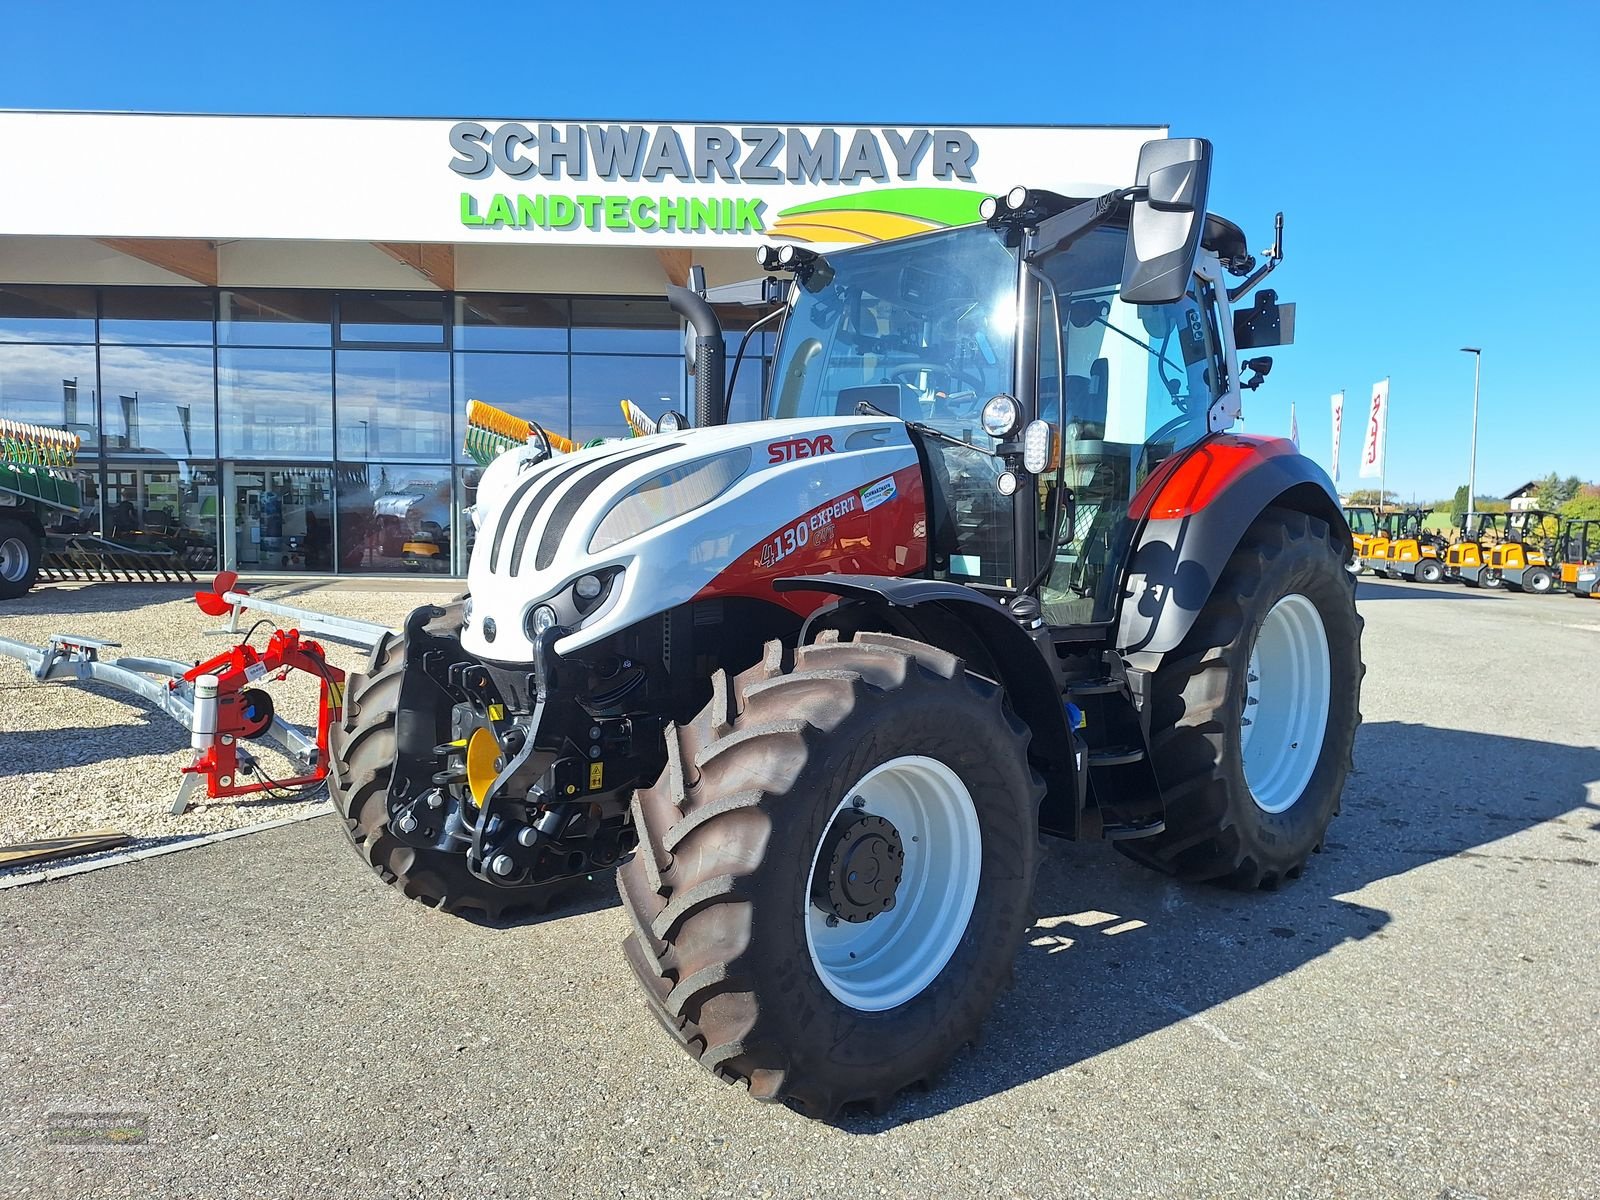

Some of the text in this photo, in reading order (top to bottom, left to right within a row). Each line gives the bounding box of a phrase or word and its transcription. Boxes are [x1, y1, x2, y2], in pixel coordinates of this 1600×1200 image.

[448, 121, 978, 183] SCHWARZMAYR
[459, 192, 765, 232] LANDTECHNIK
[767, 435, 834, 463] STEYR
[760, 496, 854, 568] 4130 EXPERT
